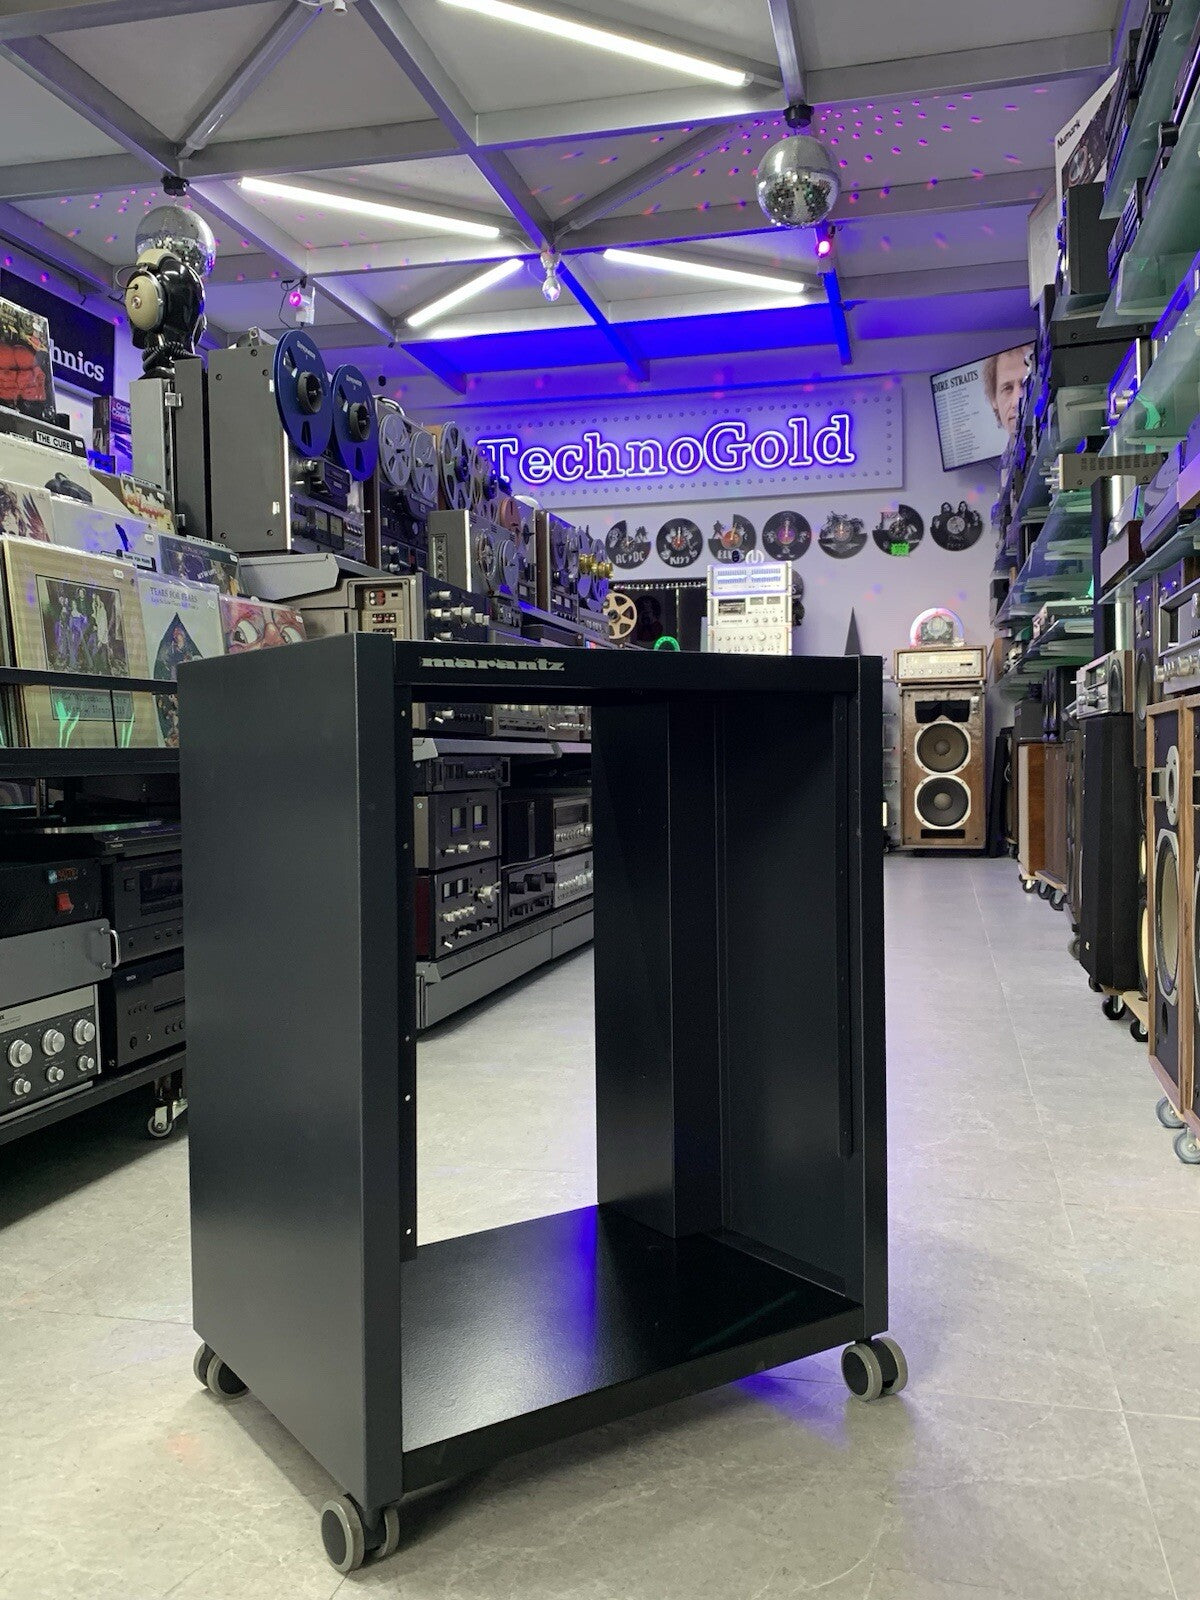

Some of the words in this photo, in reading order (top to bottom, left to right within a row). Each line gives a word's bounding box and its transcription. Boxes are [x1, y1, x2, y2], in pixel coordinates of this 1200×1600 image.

[933, 380, 949, 393] DIRE
[950, 370, 979, 389] STRAITS
[37, 432, 51, 444] THE
[53, 438, 71, 451] CURE
[477, 414, 855, 484] TechnoGold
[419, 656, 565, 671] marantz
